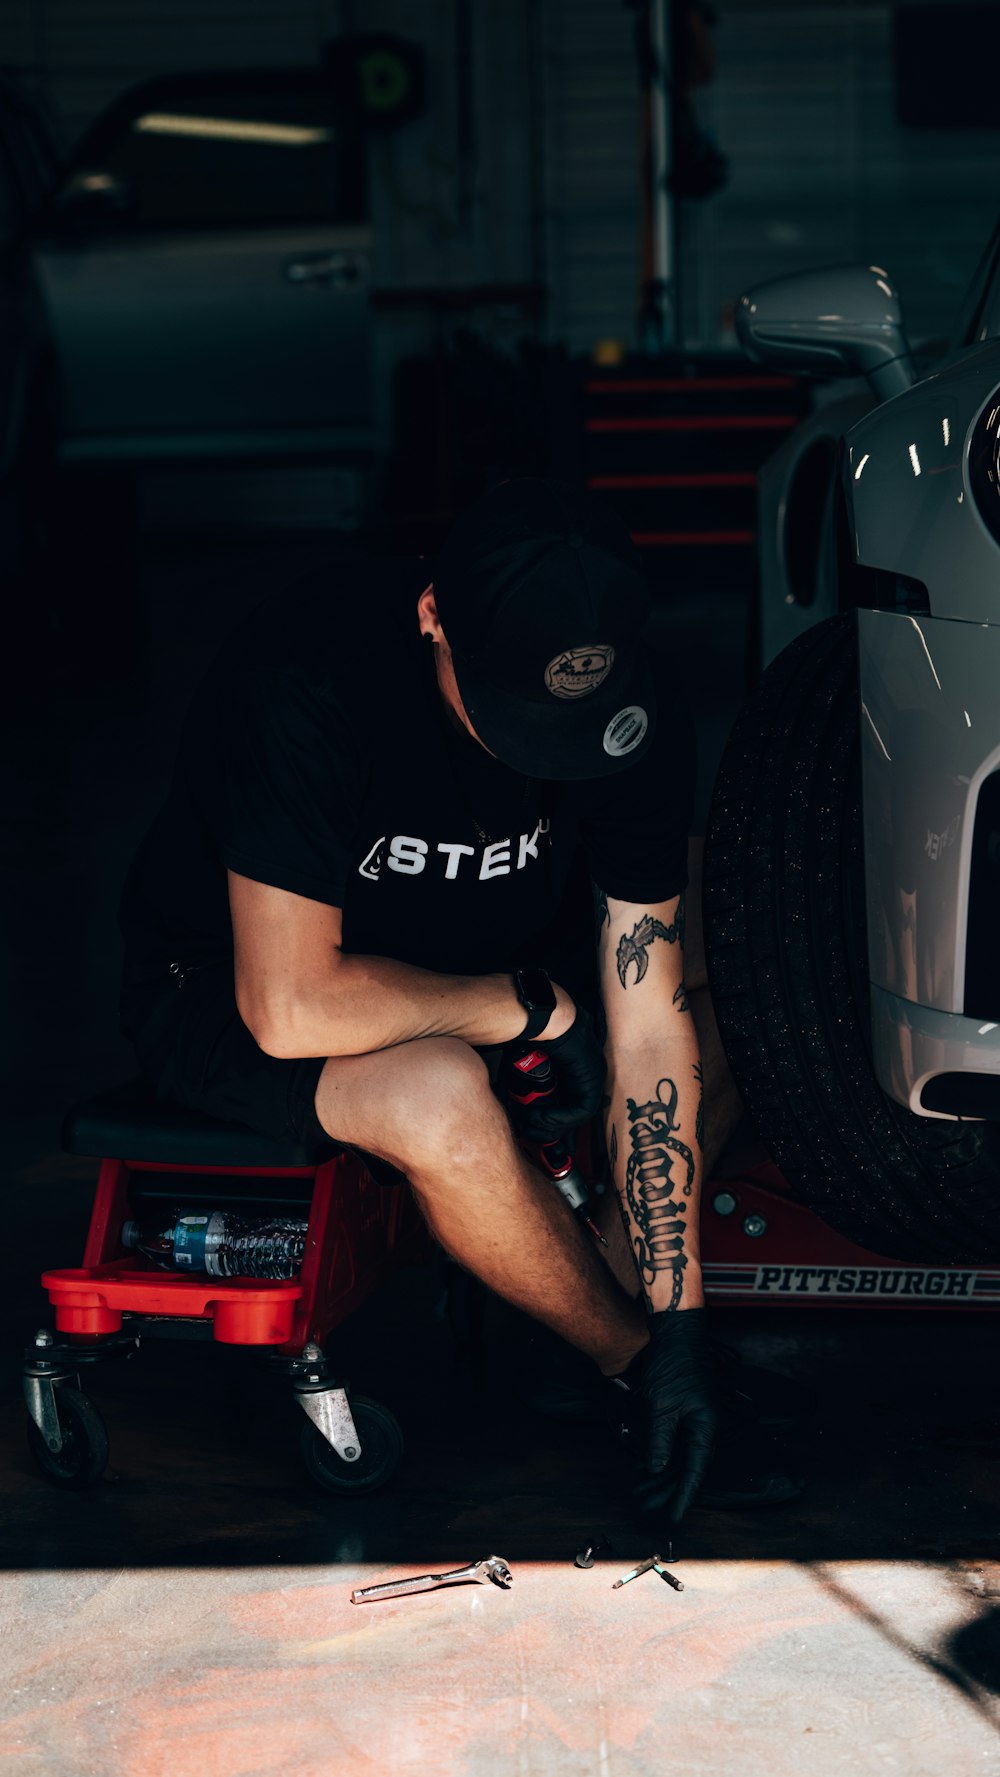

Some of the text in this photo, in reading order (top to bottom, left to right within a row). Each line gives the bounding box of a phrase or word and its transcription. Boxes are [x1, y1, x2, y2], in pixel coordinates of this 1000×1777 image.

[616, 719, 637, 743] SNAPBACK
[387, 826, 539, 881] STEK
[758, 1267, 974, 1296] PITTSBURGH
